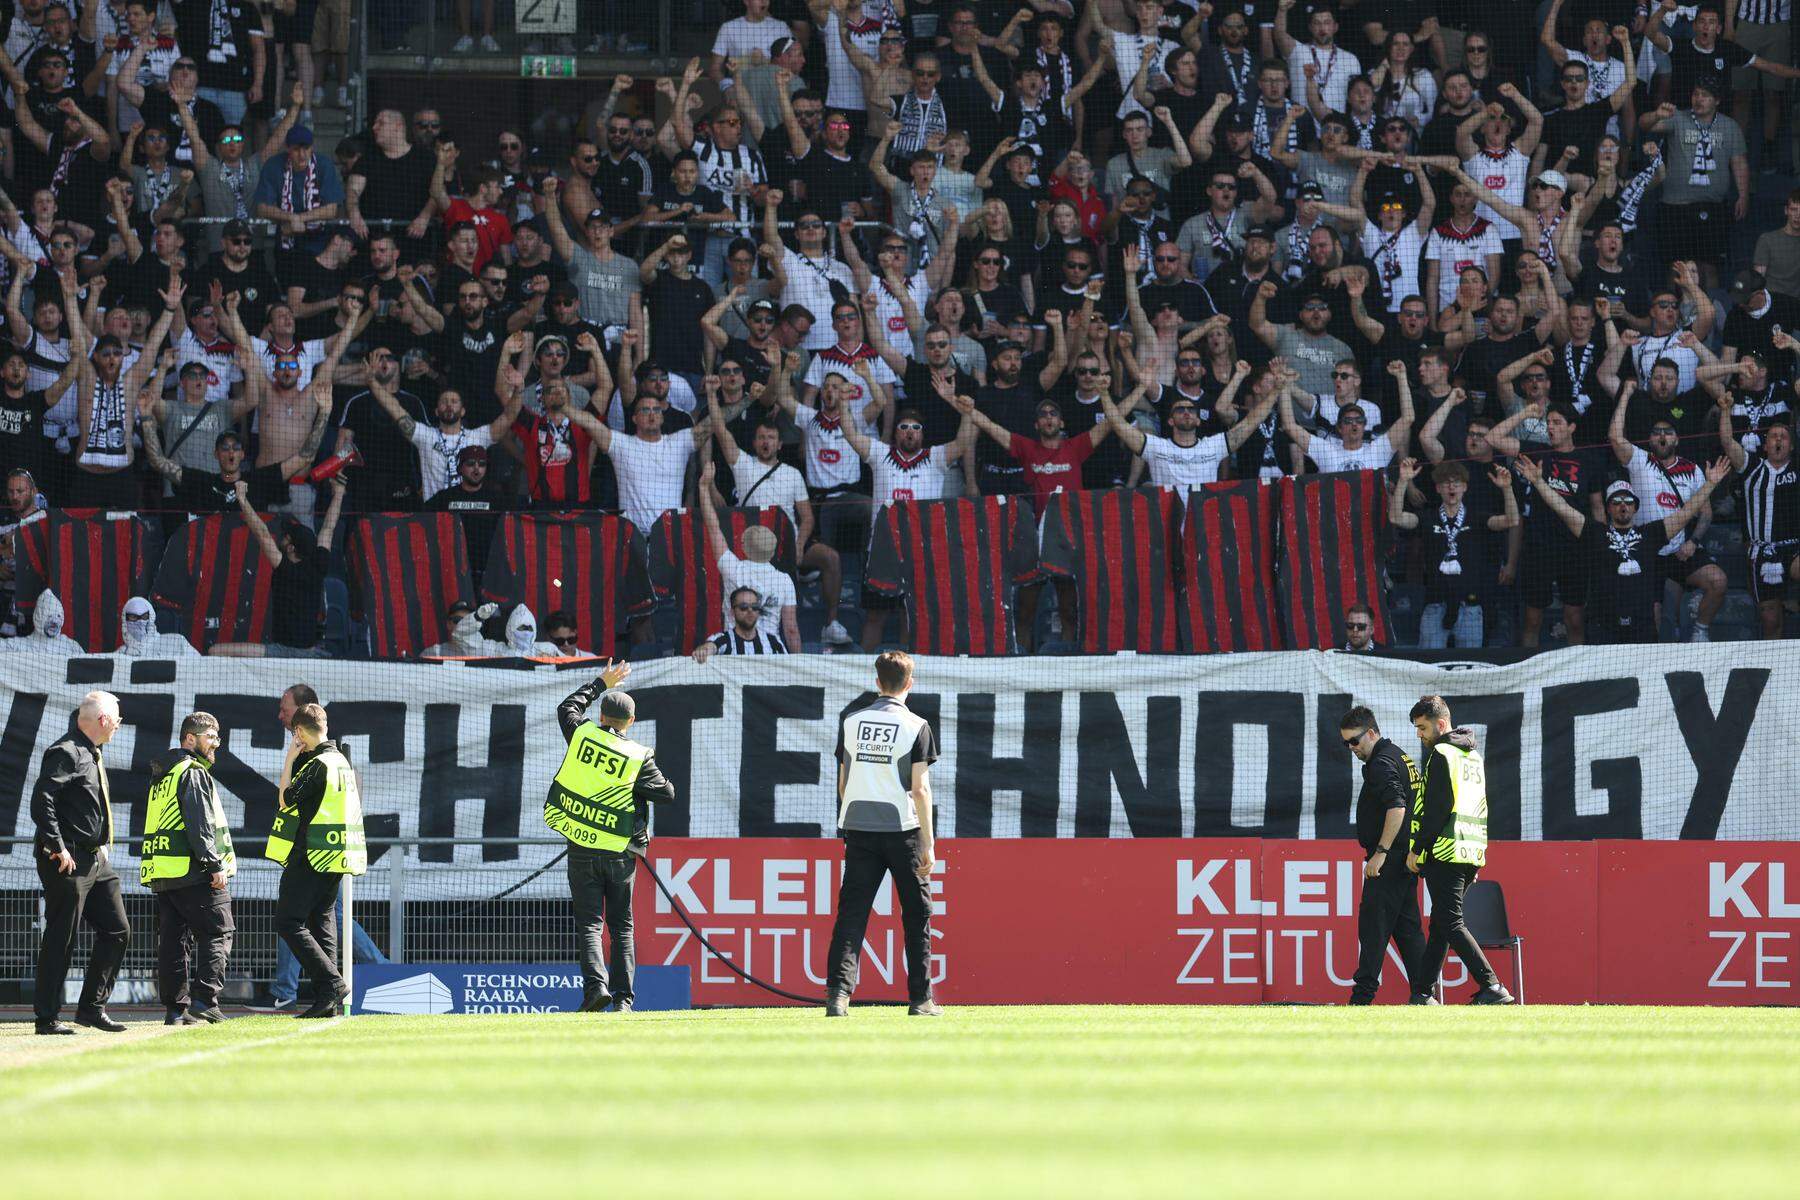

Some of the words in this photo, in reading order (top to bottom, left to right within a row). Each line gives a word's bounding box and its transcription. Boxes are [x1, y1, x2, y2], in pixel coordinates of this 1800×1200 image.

[860, 726, 892, 743] BFS
[857, 743, 893, 752] SECURITY
[580, 745, 619, 775] BFS
[560, 792, 618, 829] ORDNER
[1176, 859, 1433, 917] KLEI
[464, 989, 529, 1003] RAABA
